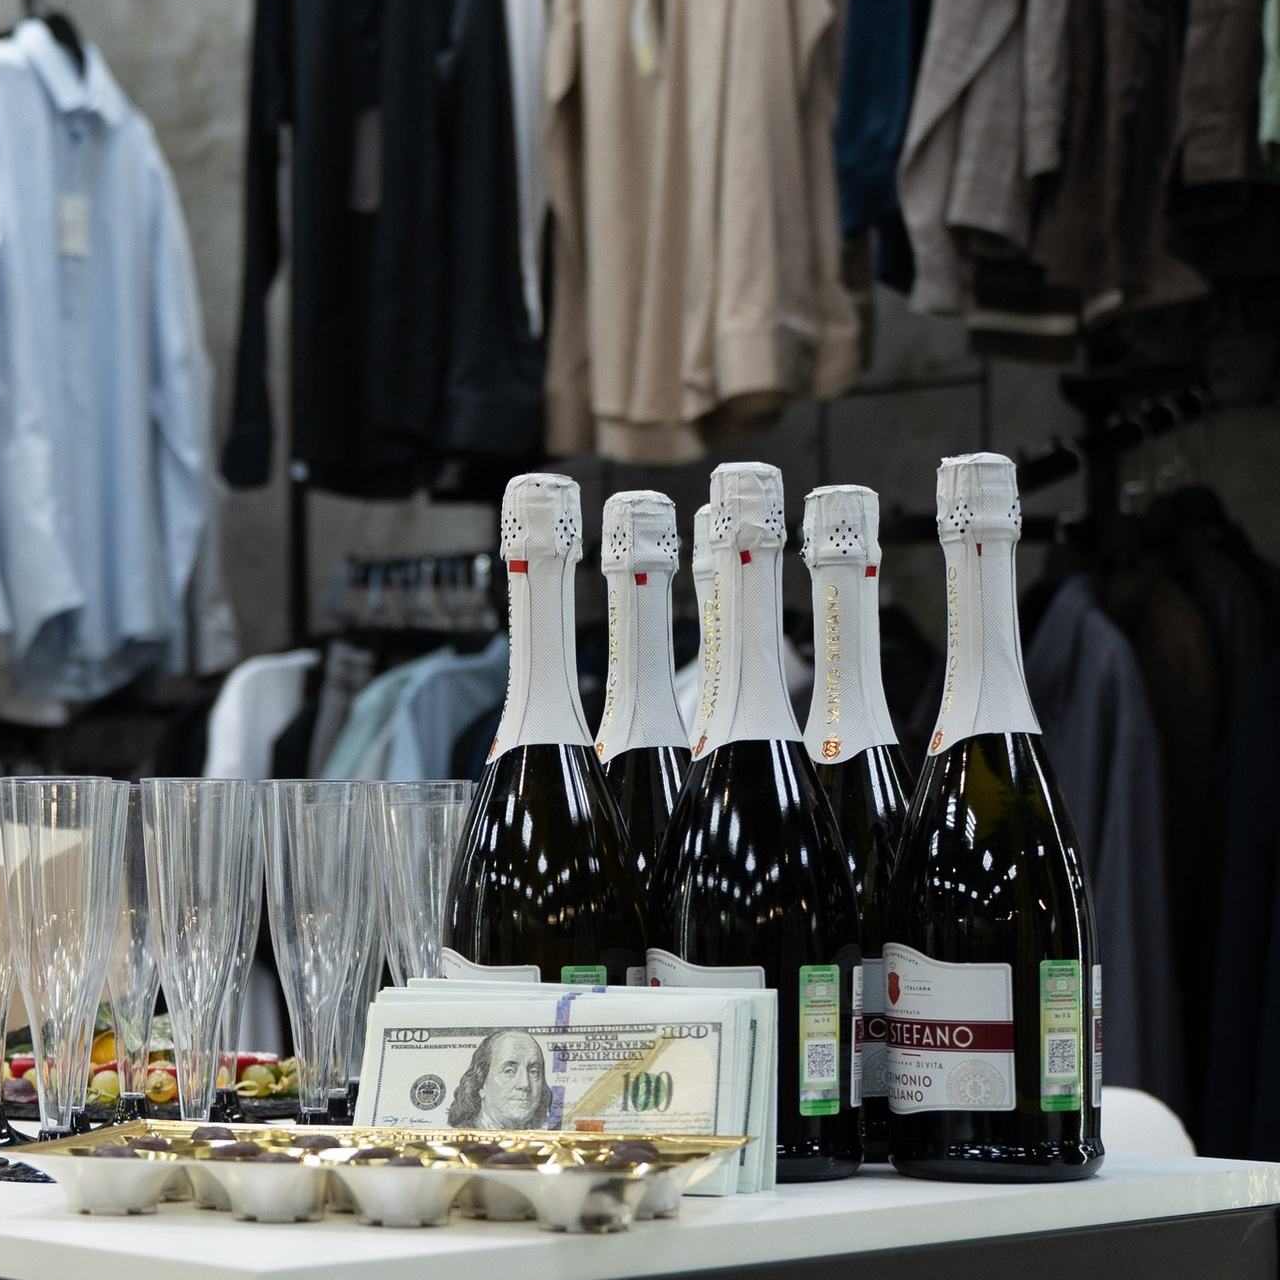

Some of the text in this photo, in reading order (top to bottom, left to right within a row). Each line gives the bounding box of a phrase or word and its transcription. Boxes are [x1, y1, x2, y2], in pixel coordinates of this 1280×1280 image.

[825, 584, 841, 725] SANTO STEFANO
[387, 1030, 431, 1043] 100
[662, 1025, 708, 1039] 100
[890, 1023, 973, 1048] STEFANO
[547, 1040, 655, 1051] UNITED STATES
[577, 1051, 645, 1061] AMERICA
[924, 1061, 943, 1070] VITA
[621, 1071, 673, 1112] 100
